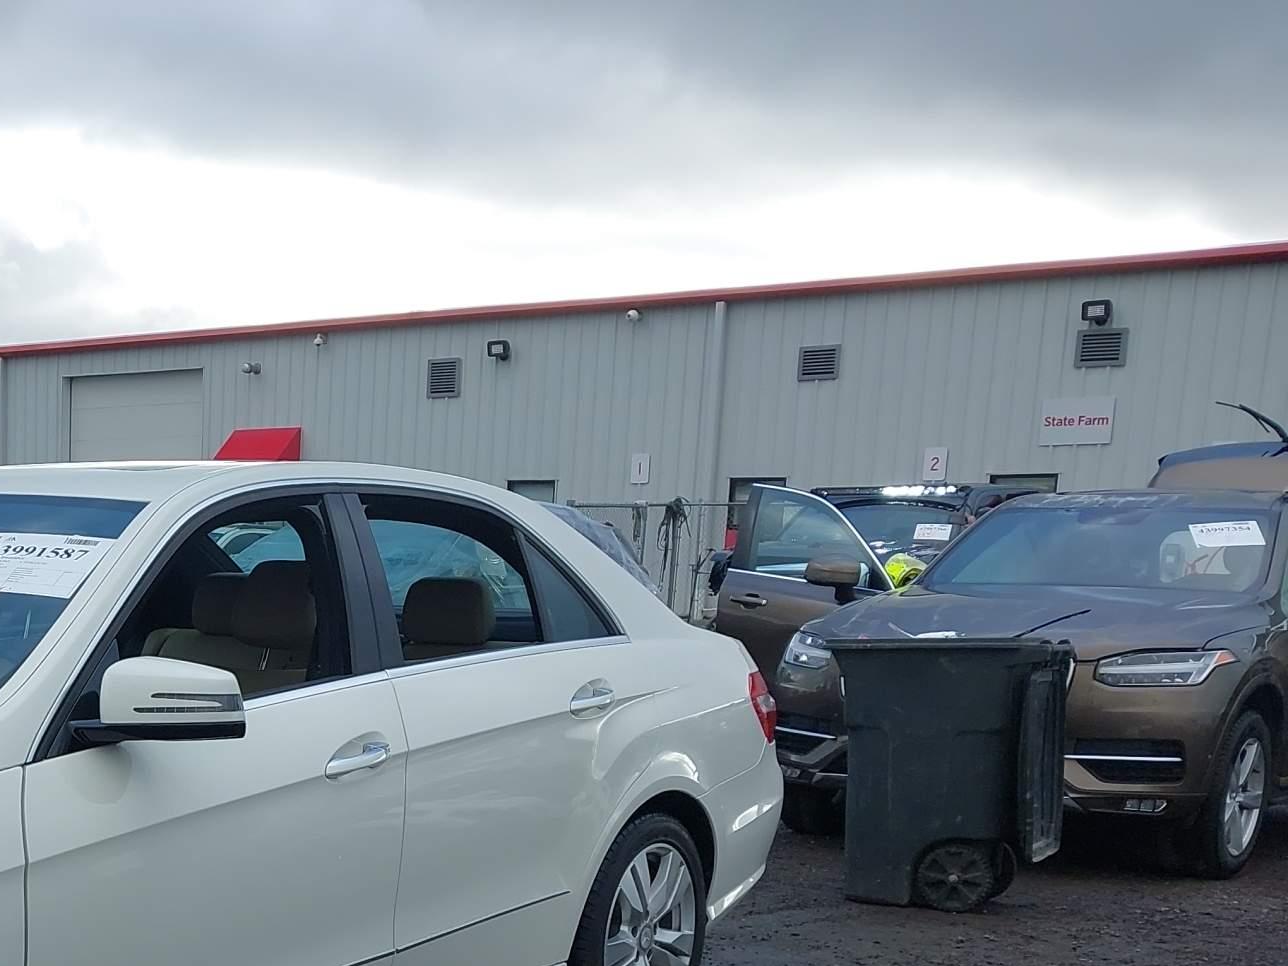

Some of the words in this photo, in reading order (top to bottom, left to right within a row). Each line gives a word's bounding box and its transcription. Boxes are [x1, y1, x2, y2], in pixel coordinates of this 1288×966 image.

[1044, 415, 1075, 427] State
[1078, 415, 1109, 426] Farm
[930, 456, 940, 471] 2
